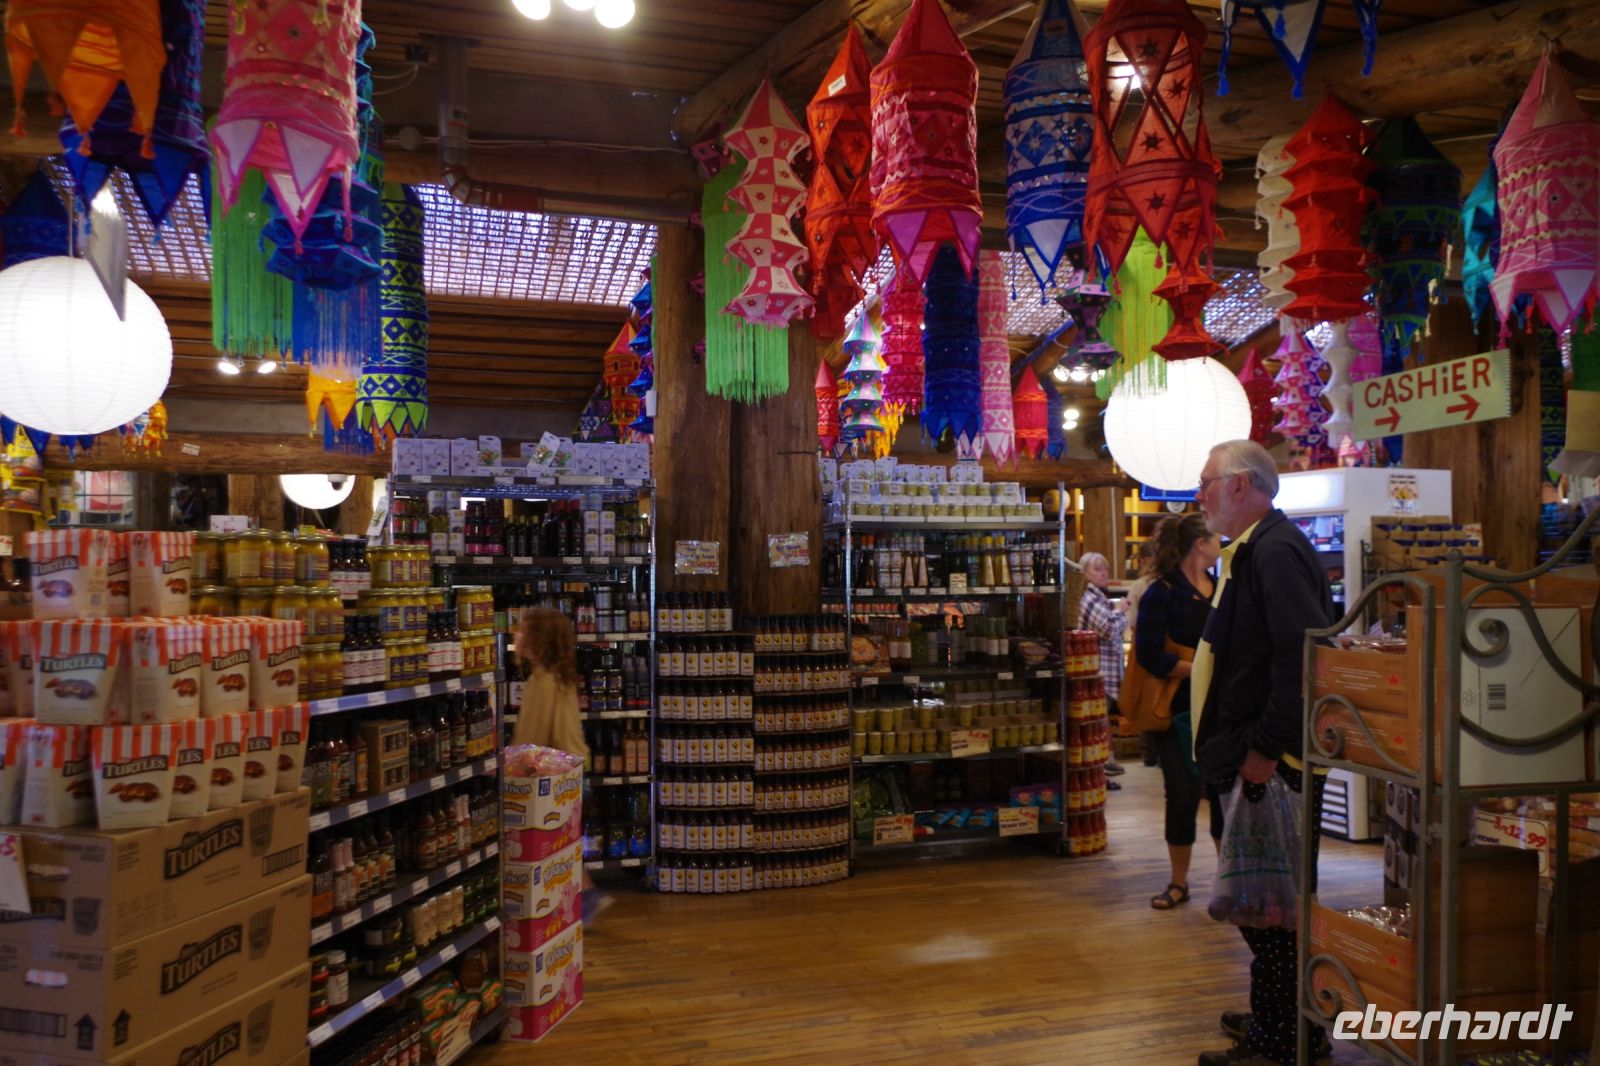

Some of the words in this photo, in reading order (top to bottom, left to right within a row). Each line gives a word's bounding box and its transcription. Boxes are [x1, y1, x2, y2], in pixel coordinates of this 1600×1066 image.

[43, 655, 105, 671] TURTLES
[105, 758, 166, 777] TURTLES
[167, 825, 241, 876] TURTLES
[164, 931, 239, 990] TURTLES
